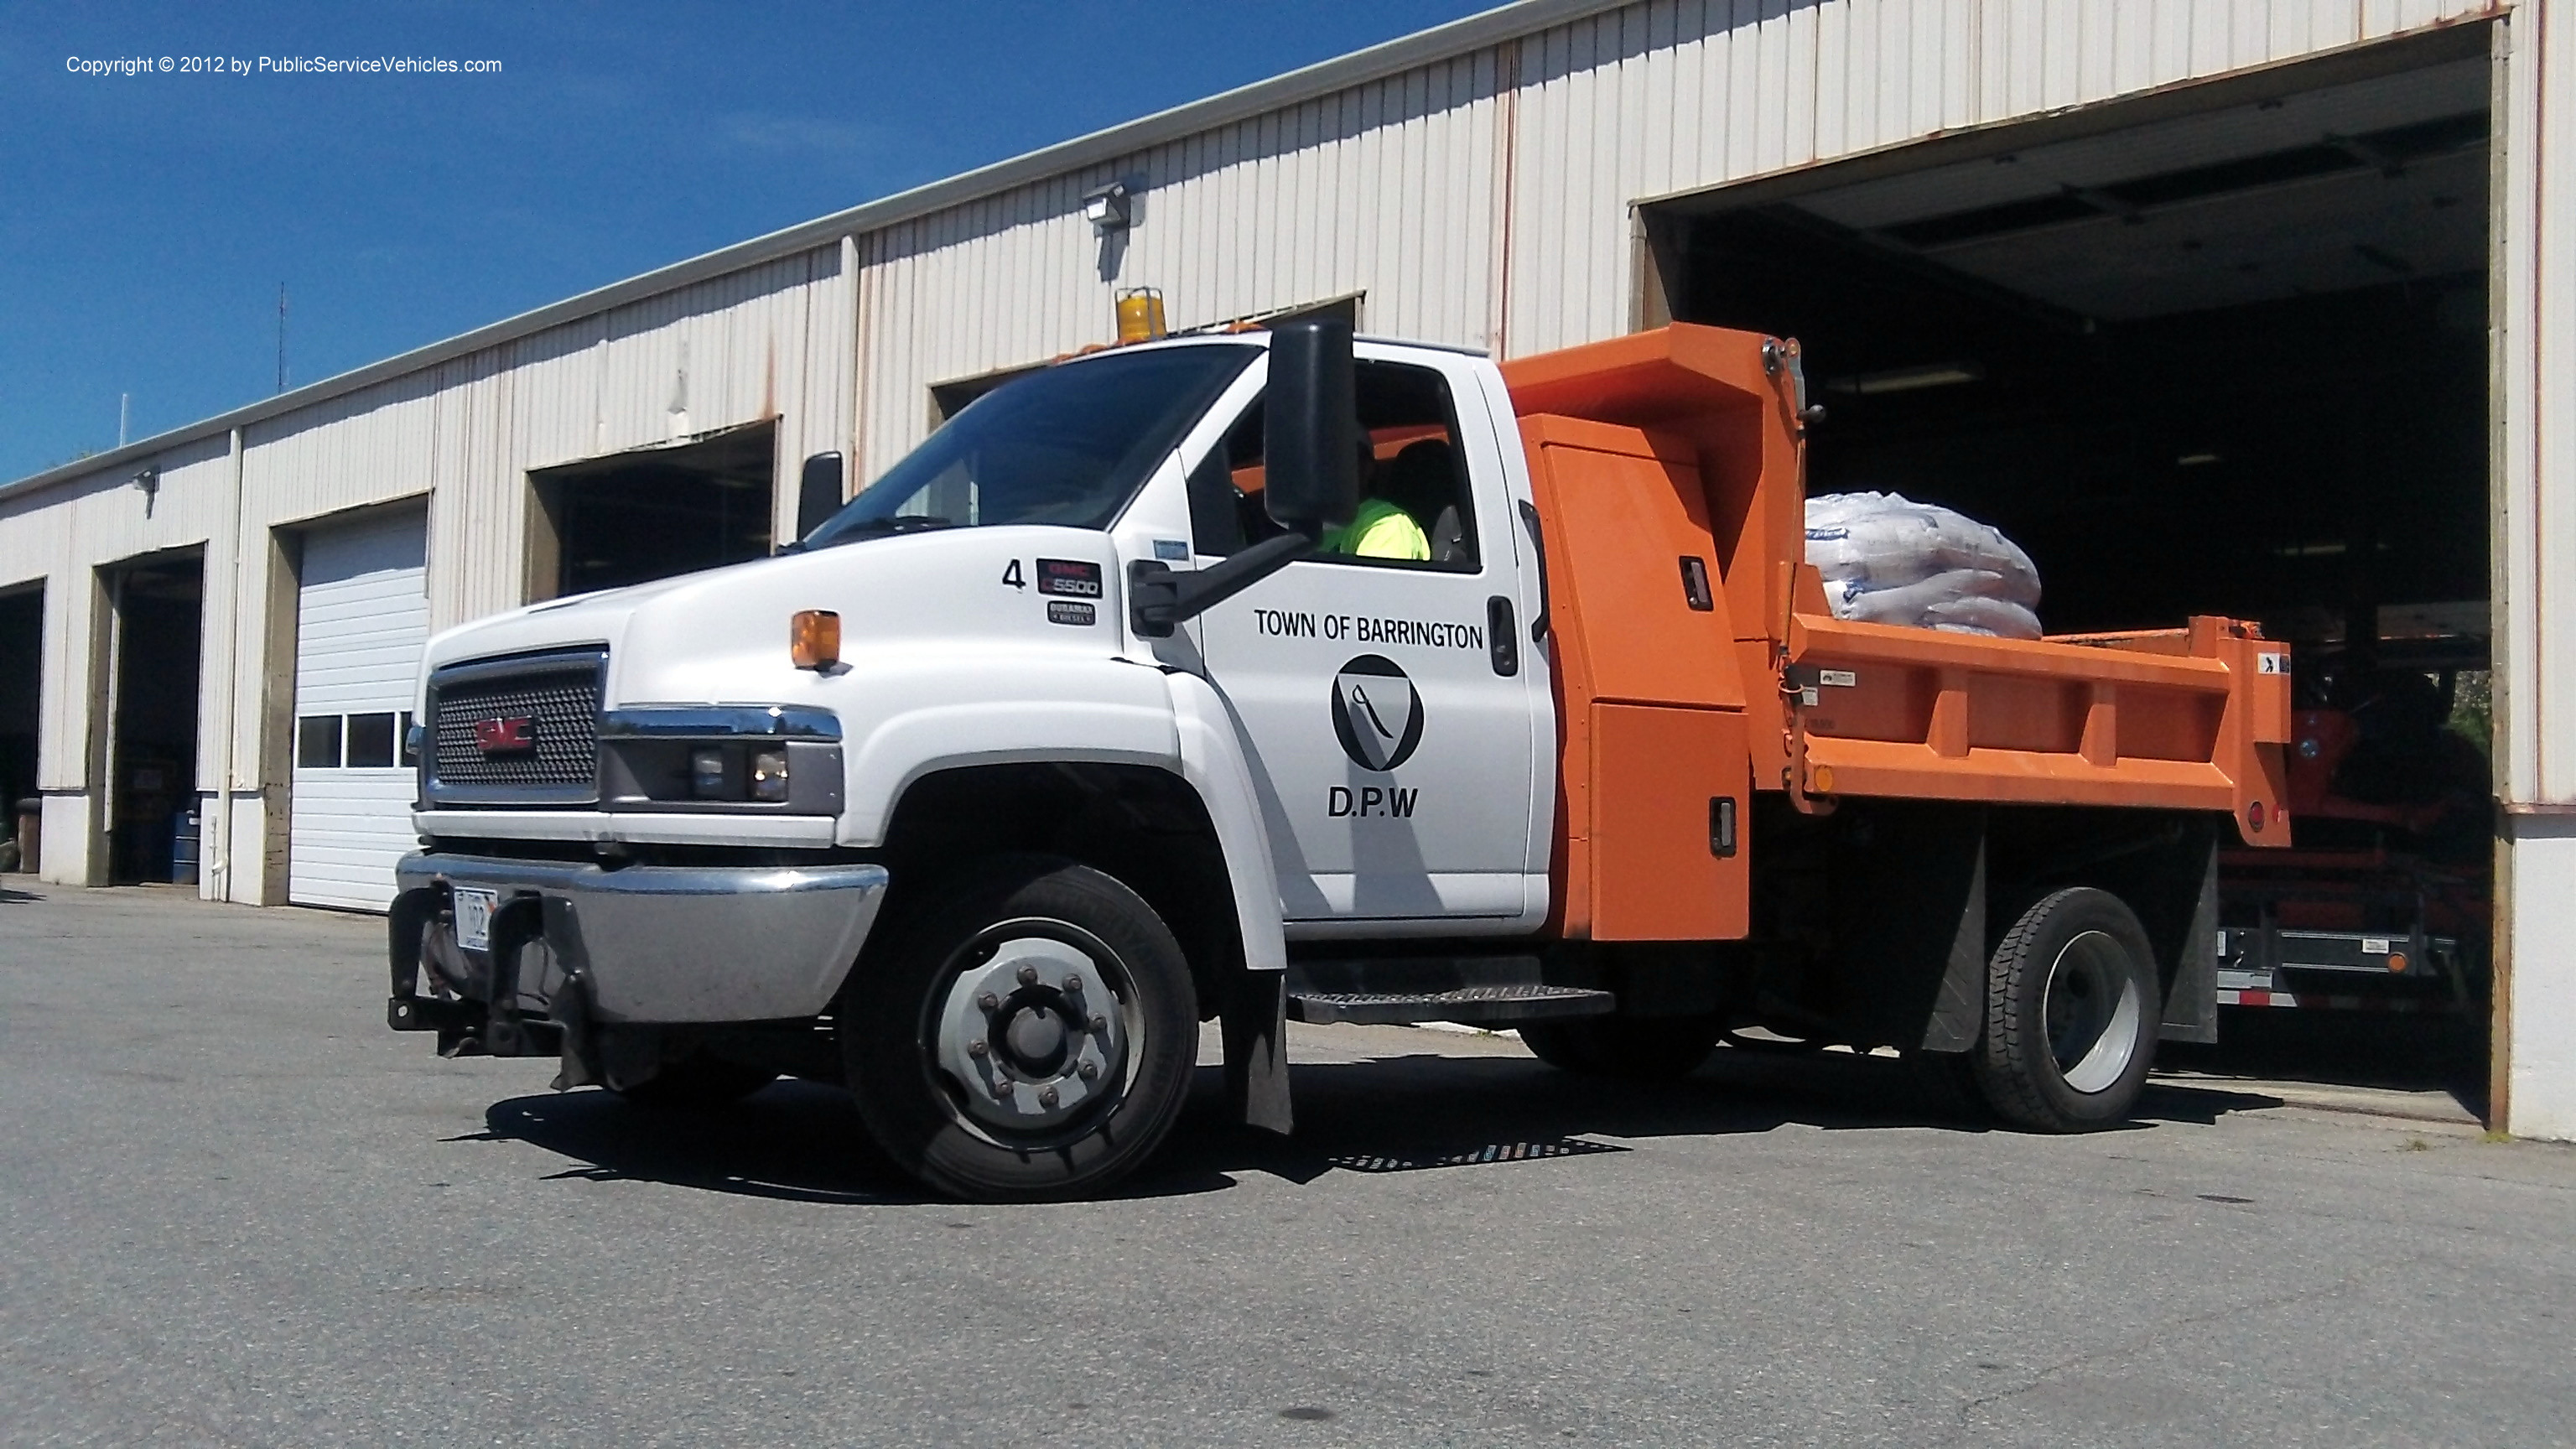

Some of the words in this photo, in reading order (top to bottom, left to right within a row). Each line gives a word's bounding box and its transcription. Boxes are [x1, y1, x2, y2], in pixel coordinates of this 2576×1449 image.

[1002, 558, 1026, 590] 4
[1048, 563, 1088, 577] GMC
[1041, 578, 1098, 595] C5500
[1254, 609, 1316, 638] TOWN
[1324, 614, 1350, 641] OF
[1357, 617, 1483, 650] BARRINGTON
[475, 715, 532, 750] GMC
[1328, 786, 1419, 818] D.P.W
